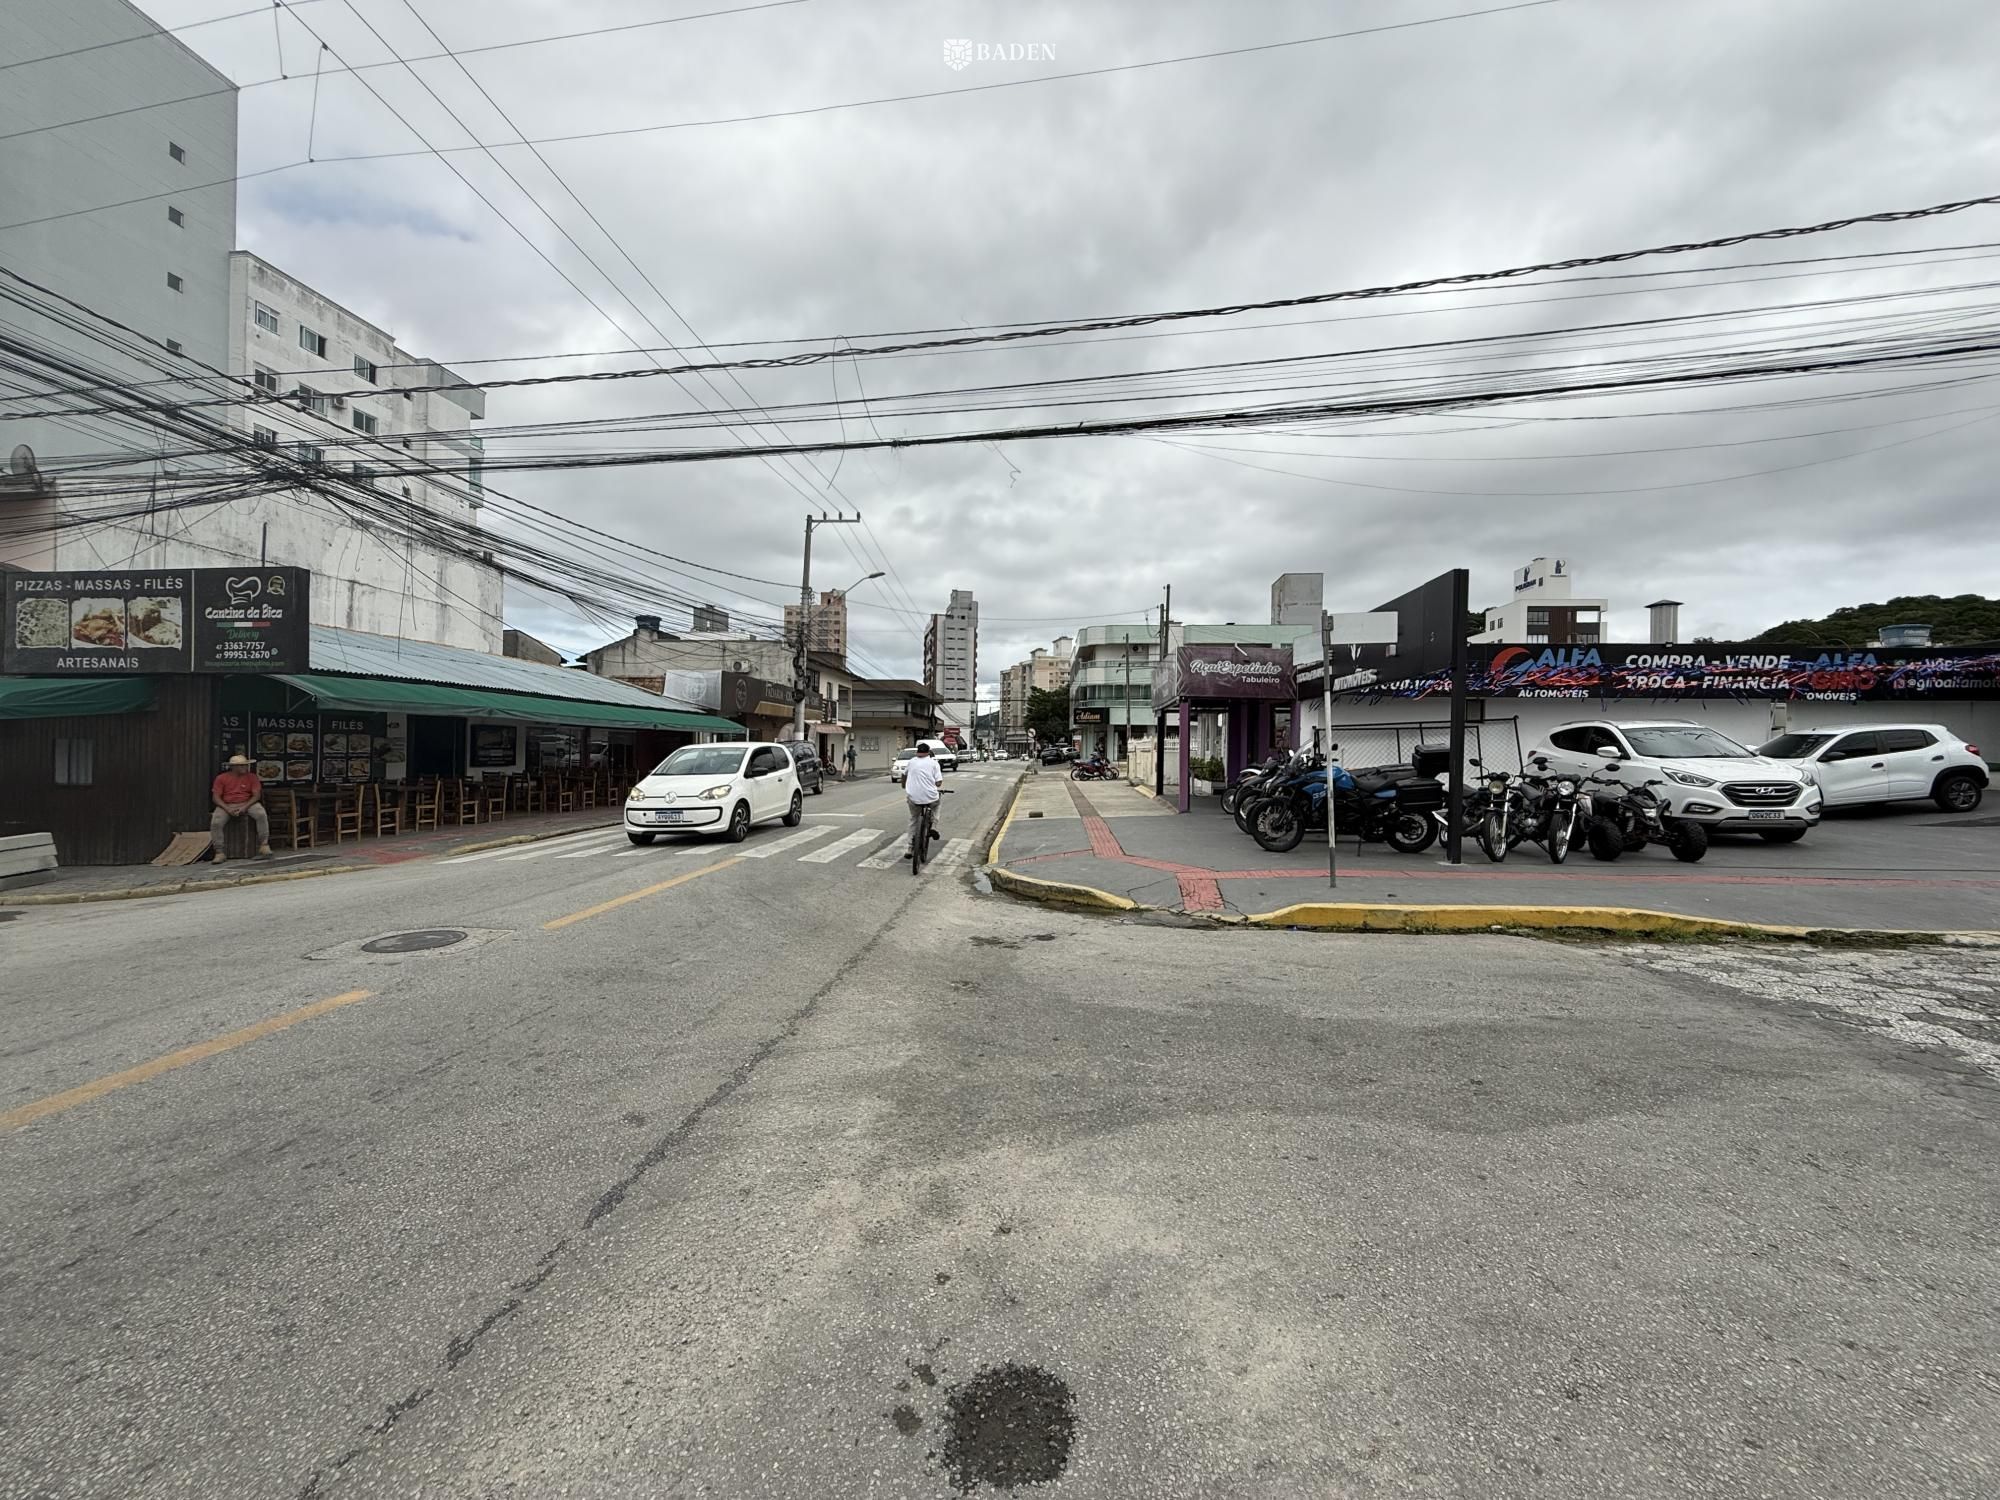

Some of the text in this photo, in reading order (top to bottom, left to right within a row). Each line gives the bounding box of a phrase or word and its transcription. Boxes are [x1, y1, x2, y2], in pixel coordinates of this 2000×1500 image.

[15, 580, 63, 592] PIZZAS
[74, 579, 131, 591] MASSAS
[143, 576, 184, 590] FILÉS
[205, 603, 283, 619] Cantina da Bica
[223, 642, 265, 650] 3363-7757
[223, 651, 270, 659] 99951-2670
[1535, 648, 1602, 668] ALFA
[57, 657, 139, 669] ARTESANAIS
[1625, 654, 1705, 669] COMPRA
[1725, 654, 1791, 669] VENDE
[1242, 676, 1280, 684] Tabuleiro
[1625, 675, 1686, 689] TROCA
[1702, 675, 1790, 690] FINANCIA
[1804, 691, 1857, 701] OMÓVEIS
[257, 718, 315, 729] MASSAS
[331, 719, 364, 730] FILÉS
